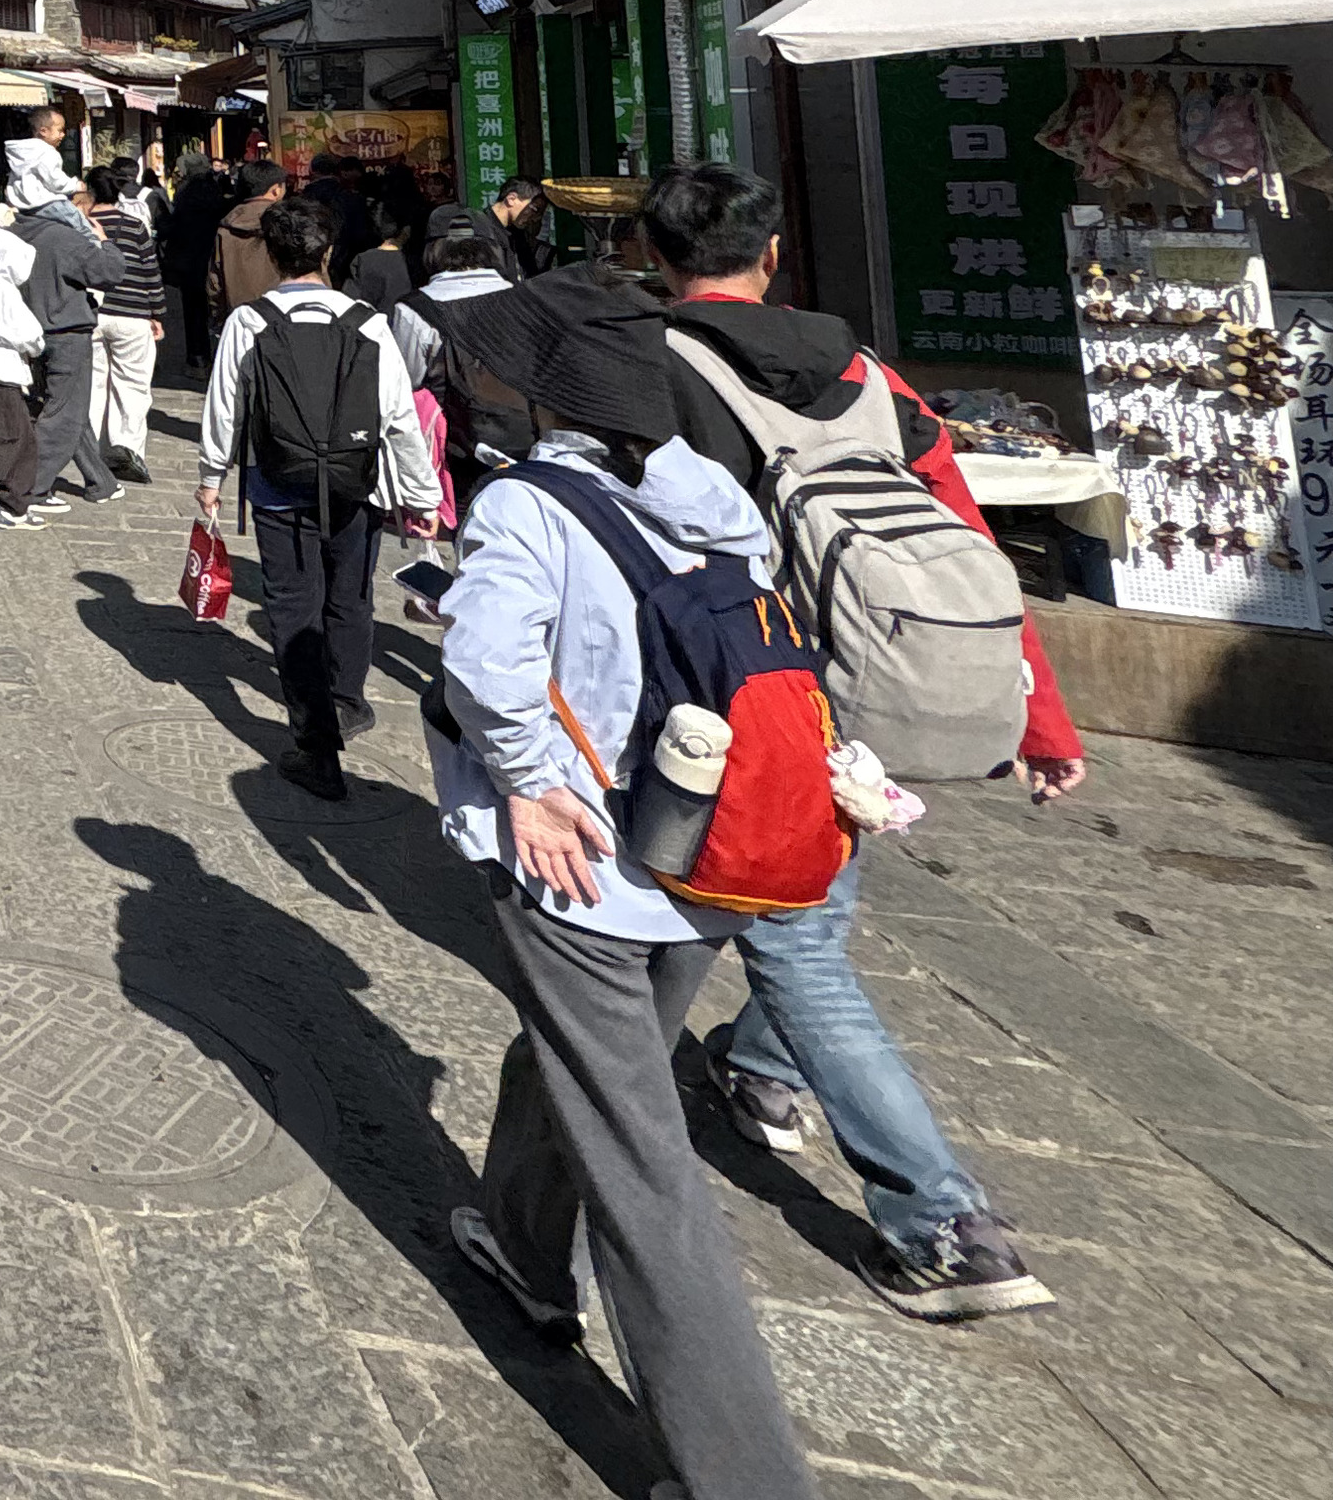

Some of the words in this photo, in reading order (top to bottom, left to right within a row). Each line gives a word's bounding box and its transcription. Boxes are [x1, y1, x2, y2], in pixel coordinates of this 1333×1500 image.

[937, 64, 1029, 278] 每日现烘
[918, 283, 1065, 323] 更新鲜
